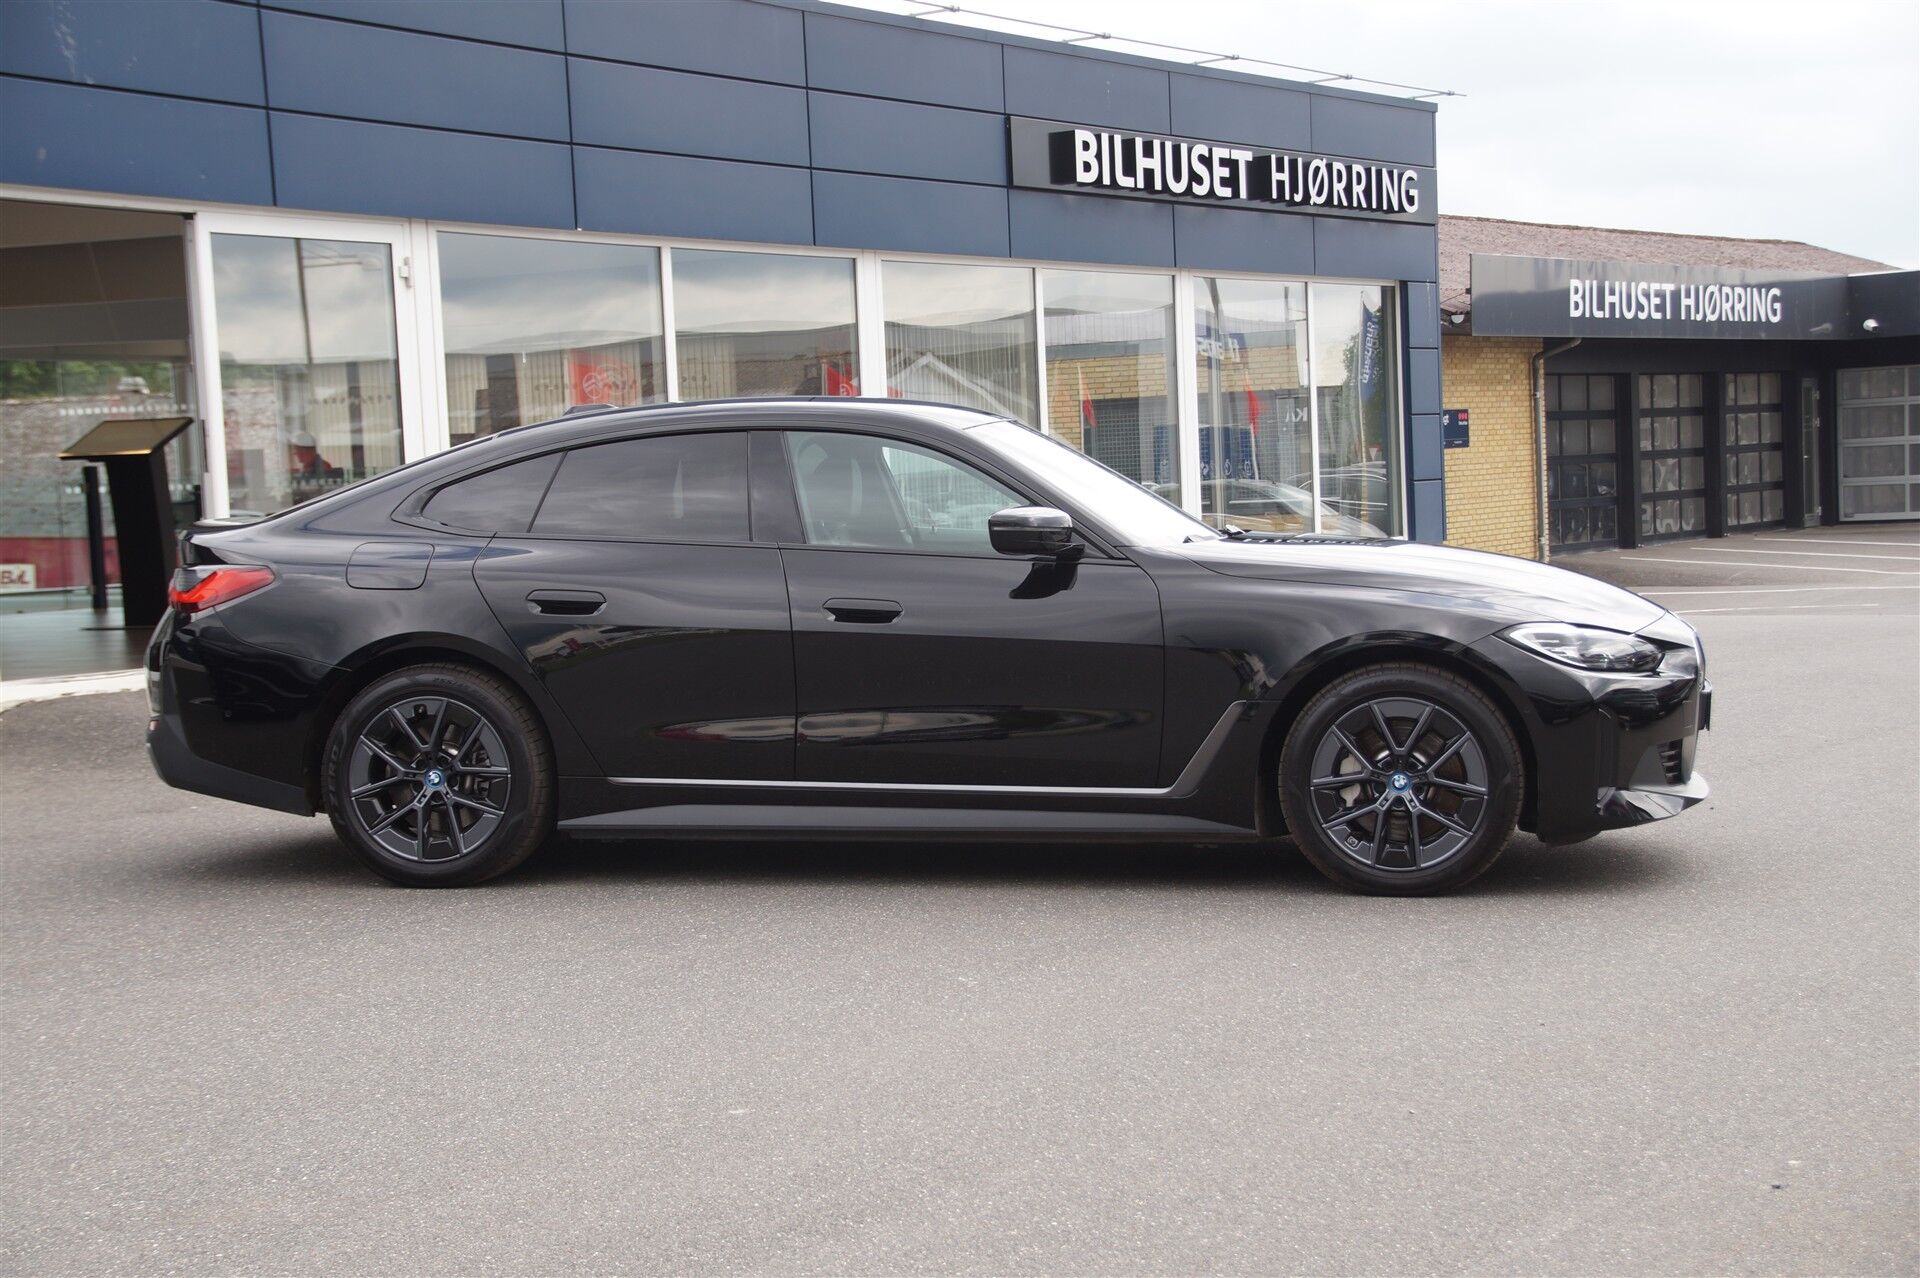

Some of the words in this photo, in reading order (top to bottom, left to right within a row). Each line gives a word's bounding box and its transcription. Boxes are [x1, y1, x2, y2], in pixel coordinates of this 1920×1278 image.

[1075, 129, 1252, 199] BILHUSET
[1271, 154, 1418, 213] HJØRRING
[1569, 279, 1674, 320] BILHUSET
[1680, 284, 1781, 323] HJØRRING
